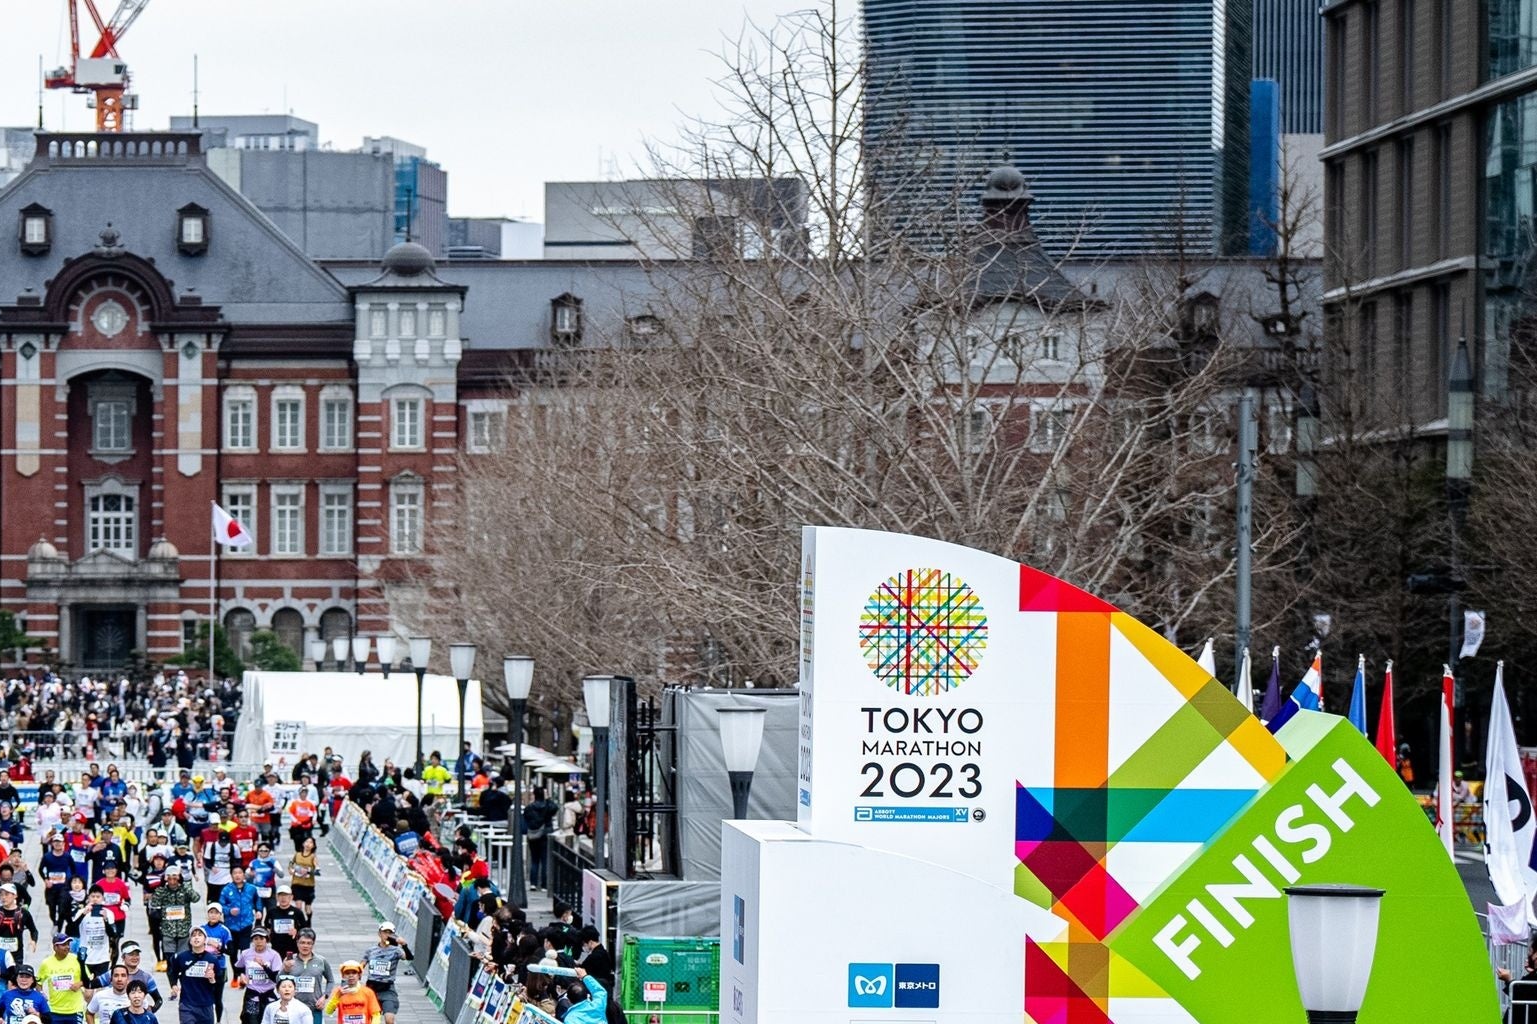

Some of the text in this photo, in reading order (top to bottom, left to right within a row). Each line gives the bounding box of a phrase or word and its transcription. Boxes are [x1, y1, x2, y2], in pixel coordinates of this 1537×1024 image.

[861, 708, 983, 733] TOKYO
[862, 741, 981, 756] MARATHON
[860, 762, 983, 798] 2023
[1152, 757, 1381, 981] FINISH
[898, 981, 936, 990] 東京メトロ
